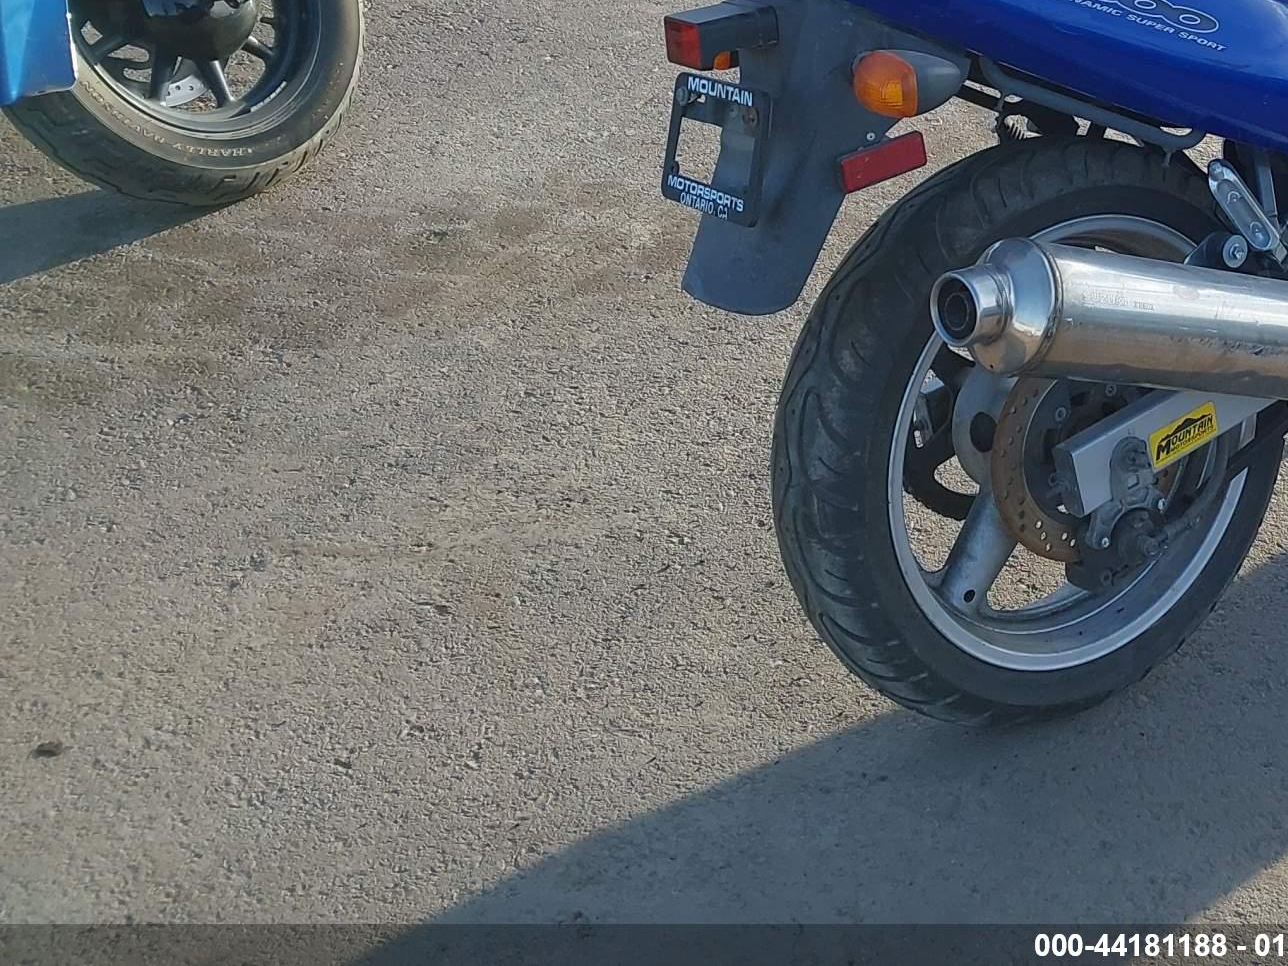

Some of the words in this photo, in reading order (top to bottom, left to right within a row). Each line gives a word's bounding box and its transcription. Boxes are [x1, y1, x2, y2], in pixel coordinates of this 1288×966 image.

[1126, 13, 1175, 34] SUPER
[1178, 31, 1227, 52] SPORT
[687, 76, 753, 107] MOUNTAIN
[667, 174, 744, 212] MOTORSPORTS
[717, 204, 728, 220] CA
[1156, 414, 1214, 461] MOUNTAIN
